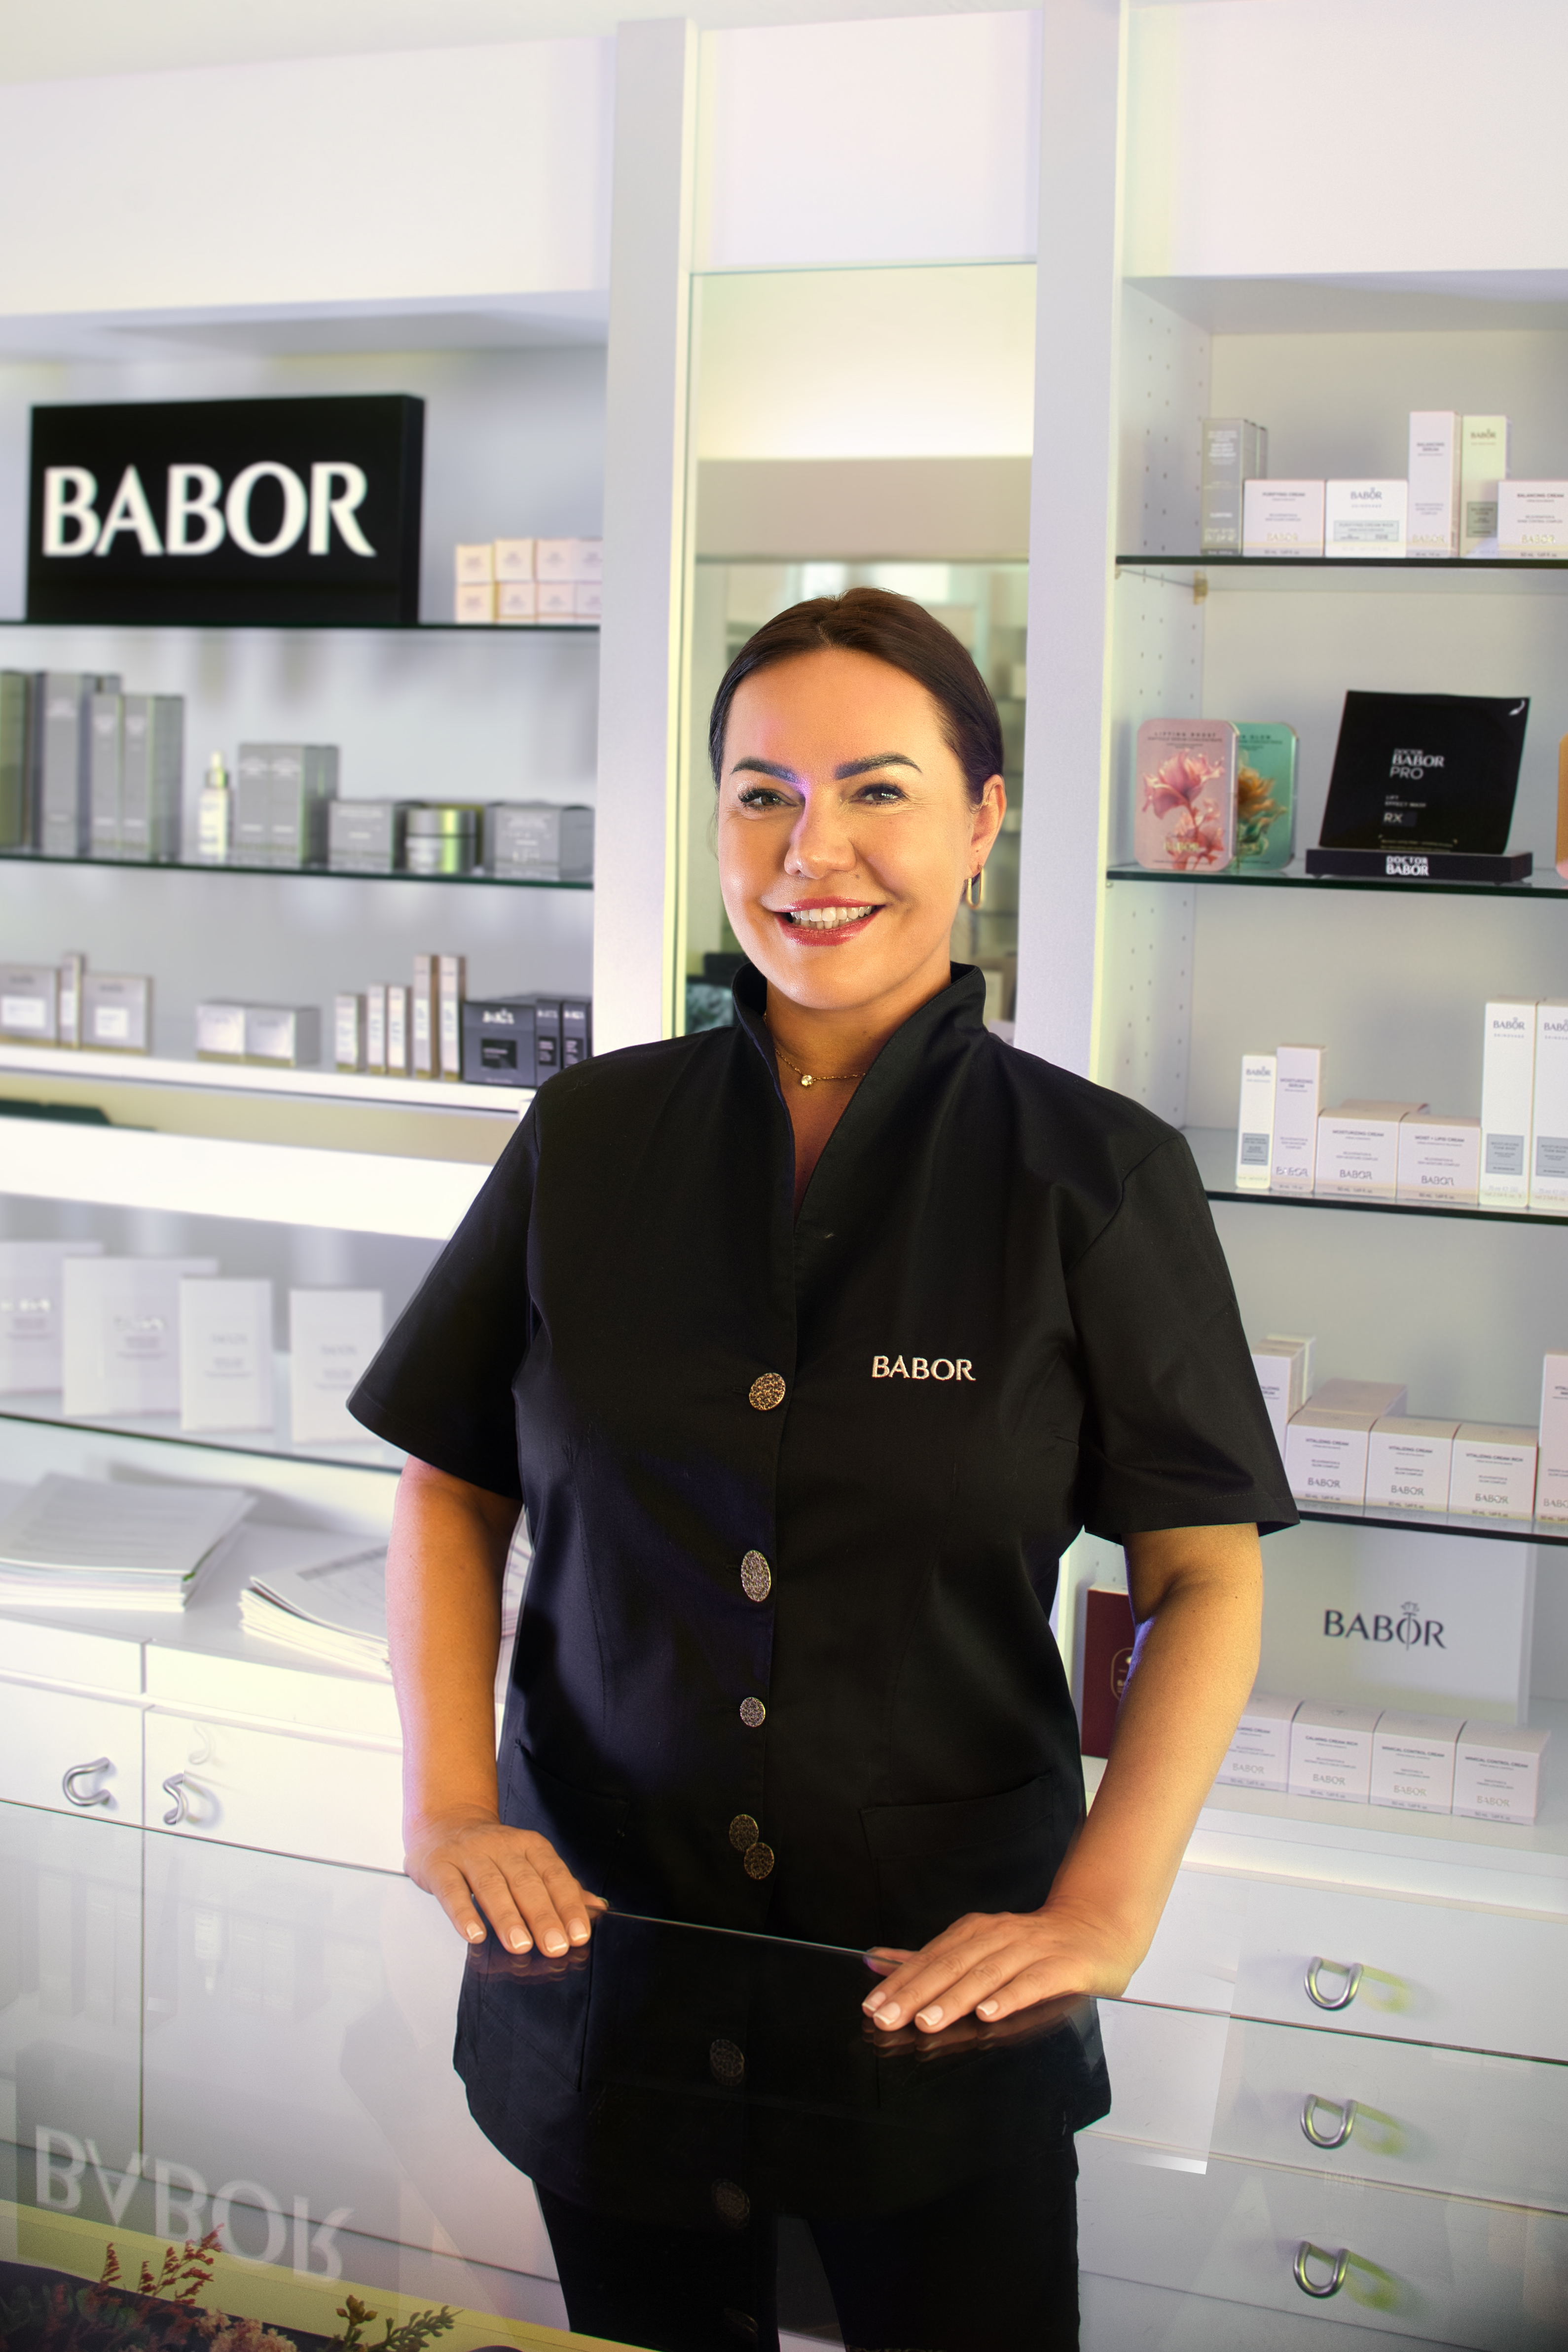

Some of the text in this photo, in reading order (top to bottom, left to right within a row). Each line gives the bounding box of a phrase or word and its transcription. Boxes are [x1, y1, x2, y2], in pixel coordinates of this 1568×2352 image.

[1350, 491, 1383, 501] BABOR
[42, 461, 377, 557] BABOR
[1267, 533, 1298, 542] BABOR
[1413, 534, 1445, 543] BABOR
[1521, 534, 1555, 543] BABOR
[1392, 754, 1445, 768] BABOR
[1390, 766, 1423, 779] PRO
[1383, 811, 1404, 823] RX
[1386, 856, 1428, 864] DOCTOR
[1386, 864, 1429, 876] BABOR
[1493, 1020, 1525, 1030] BABOR
[1246, 1068, 1271, 1076] BABOR
[1339, 1169, 1373, 1180] BABOR
[872, 1355, 977, 1381] BABOR
[1308, 1477, 1341, 1488] BABOR
[1391, 1484, 1425, 1496] BABOR
[1475, 1493, 1509, 1505] BABOR
[1324, 1609, 1447, 1650] BABOR
[1232, 1763, 1265, 1775] BABOR
[1313, 1773, 1346, 1786] BABOR
[1394, 1784, 1427, 1797] BABOR
[1477, 1795, 1510, 1808] BABOR
